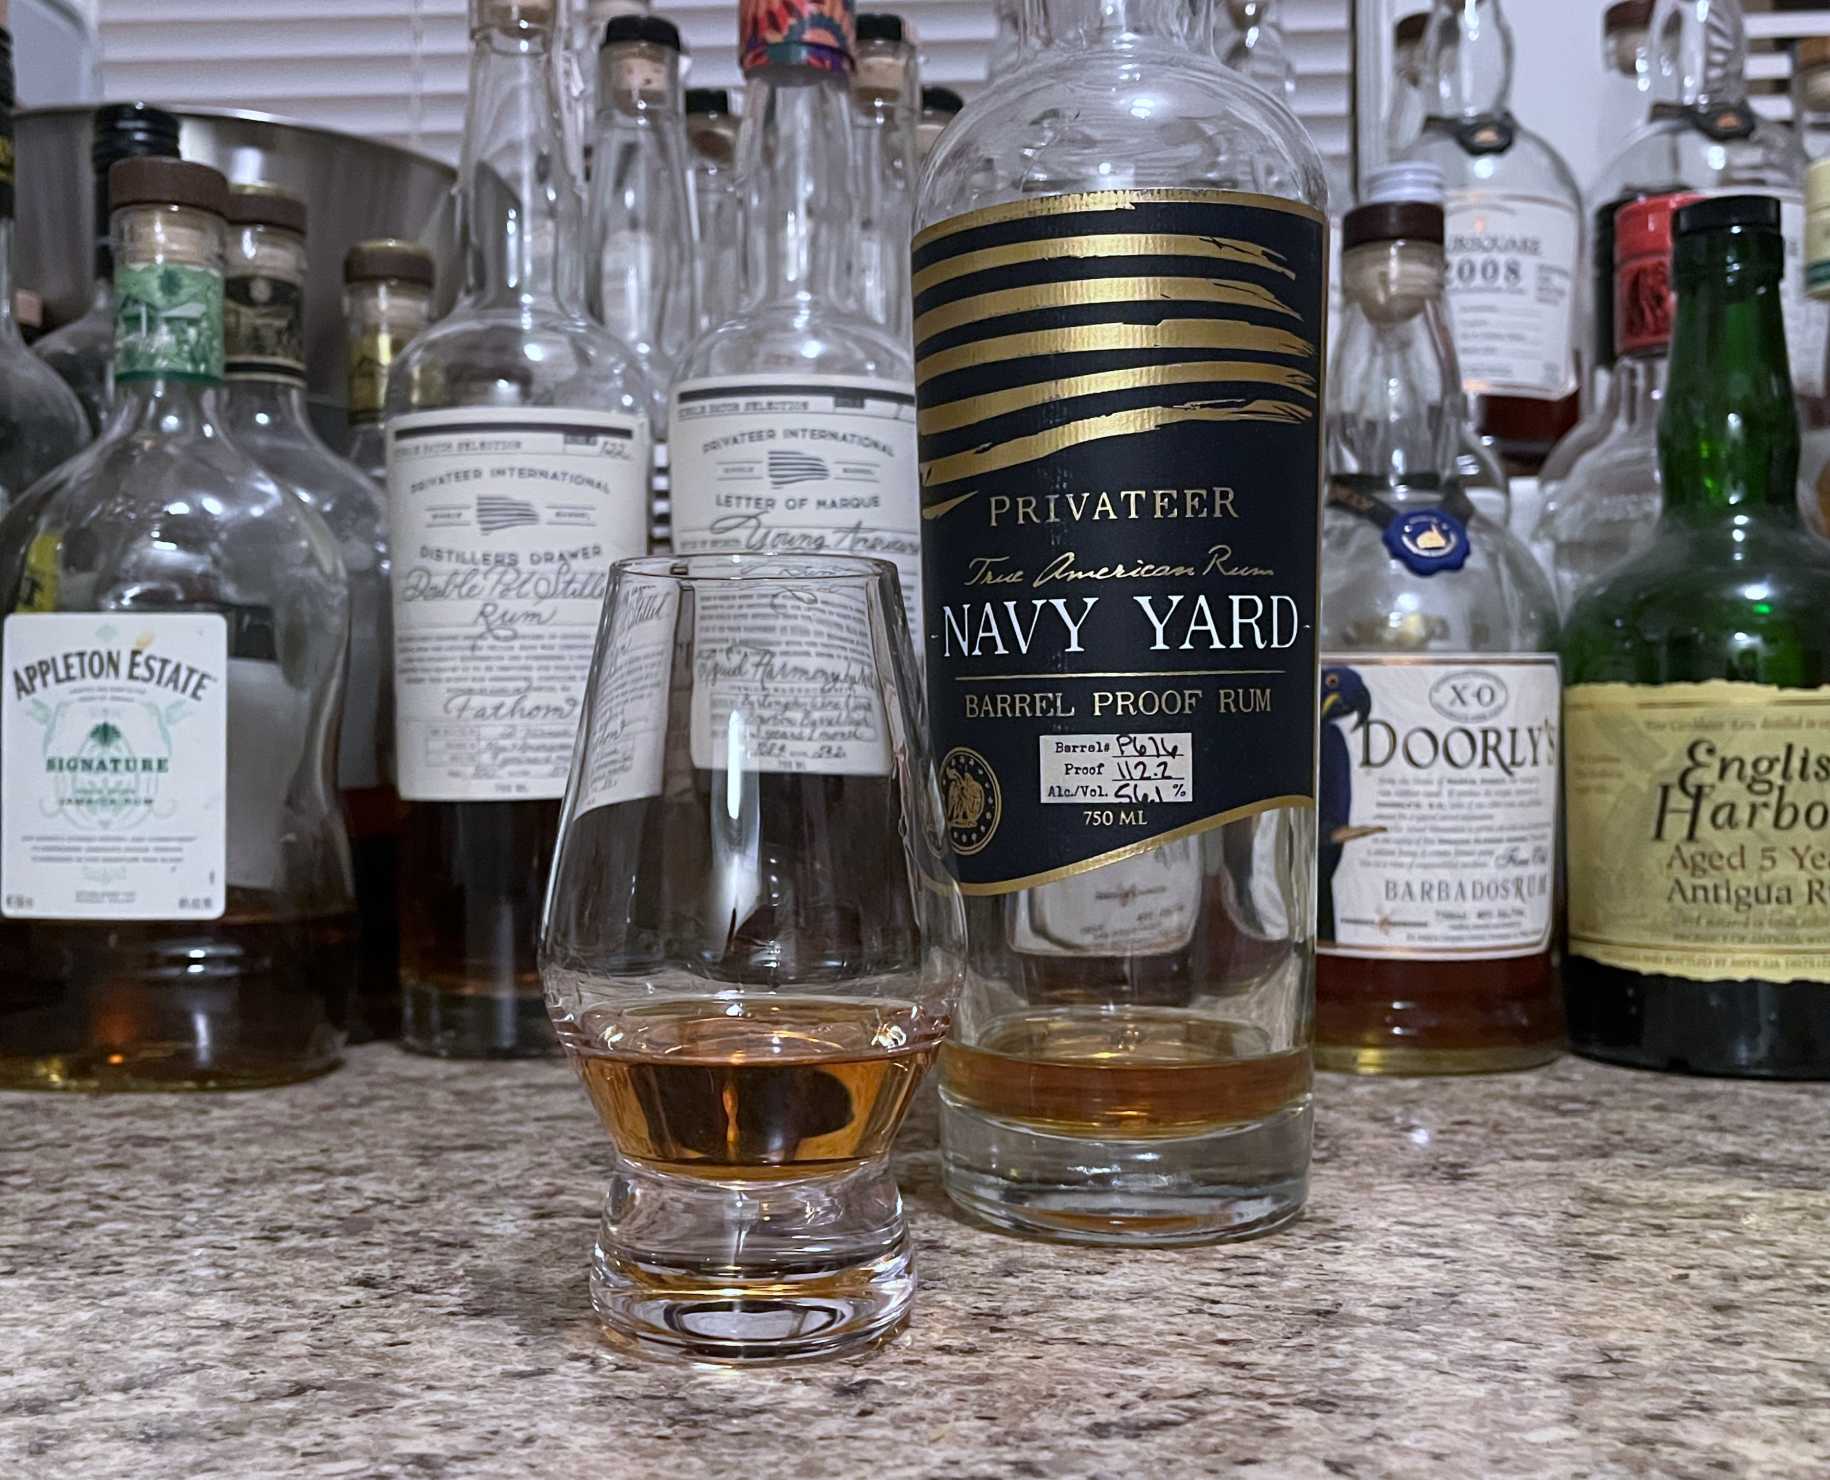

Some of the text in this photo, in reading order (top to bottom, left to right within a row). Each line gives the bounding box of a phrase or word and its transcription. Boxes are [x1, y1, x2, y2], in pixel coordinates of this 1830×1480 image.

[703, 428, 894, 457] PRIVATEER INTERNATIONAL
[410, 468, 611, 495] PRIVATEER INTERNATIONAL
[715, 493, 881, 511] LETTER OF MARQUE
[989, 487, 1239, 527] PRIVATEER
[420, 545, 603, 567] DISTILLERS DRAWER
[964, 544, 1275, 588] True American Rum
[943, 595, 1300, 657] NAVY YARD
[13, 648, 211, 702] APPLETON ESTATE
[966, 687, 1273, 719] BARREL PROOF RUM
[1358, 717, 1556, 776] DOORLY'S
[46, 755, 169, 774] SIGNATURE
[1064, 761, 1173, 781] Proof 112.2
[1172, 784, 1187, 797] %
[1083, 810, 1148, 826] 750 ML
[1653, 783, 1829, 842] Harbo
[1667, 844, 1830, 877] Aged 5 Ye
[1385, 878, 1512, 903] BARBADOS
[1667, 878, 1792, 912] Antigua
